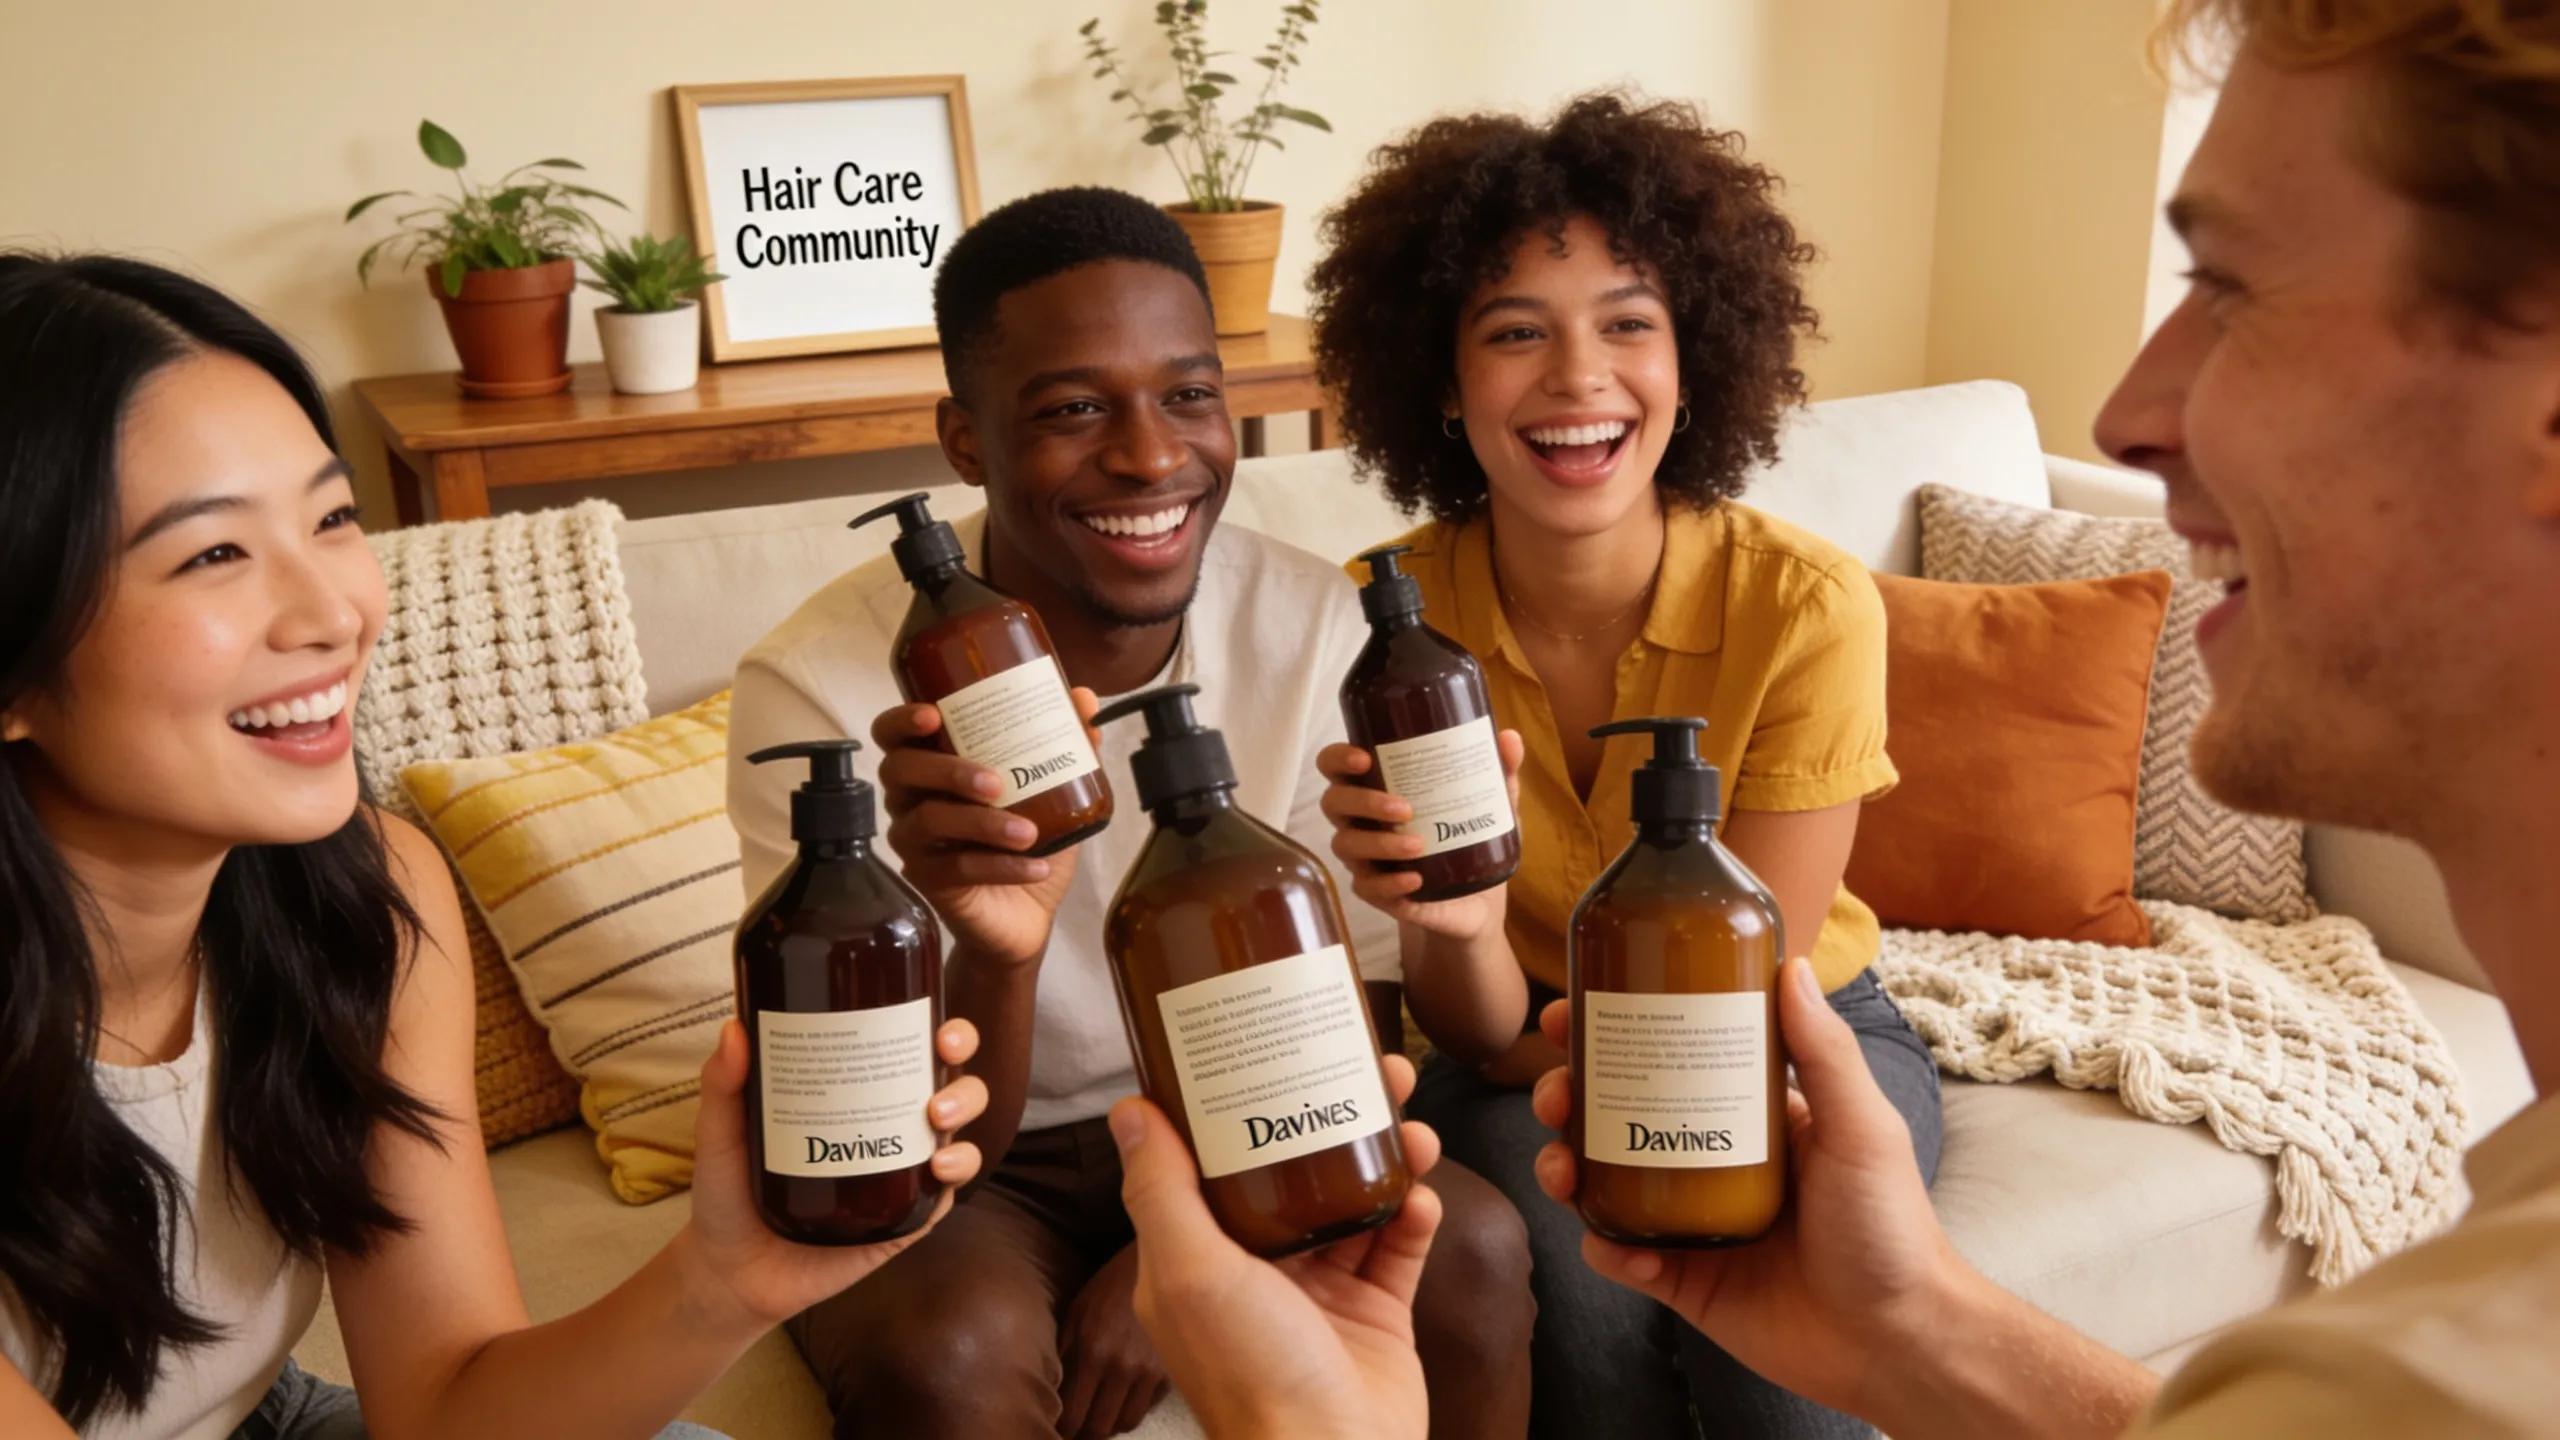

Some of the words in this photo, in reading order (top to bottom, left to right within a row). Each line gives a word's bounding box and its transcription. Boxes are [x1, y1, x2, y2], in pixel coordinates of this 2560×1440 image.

[742, 166, 822, 212] Hair
[834, 161, 923, 206] Care
[736, 216, 940, 269] Community
